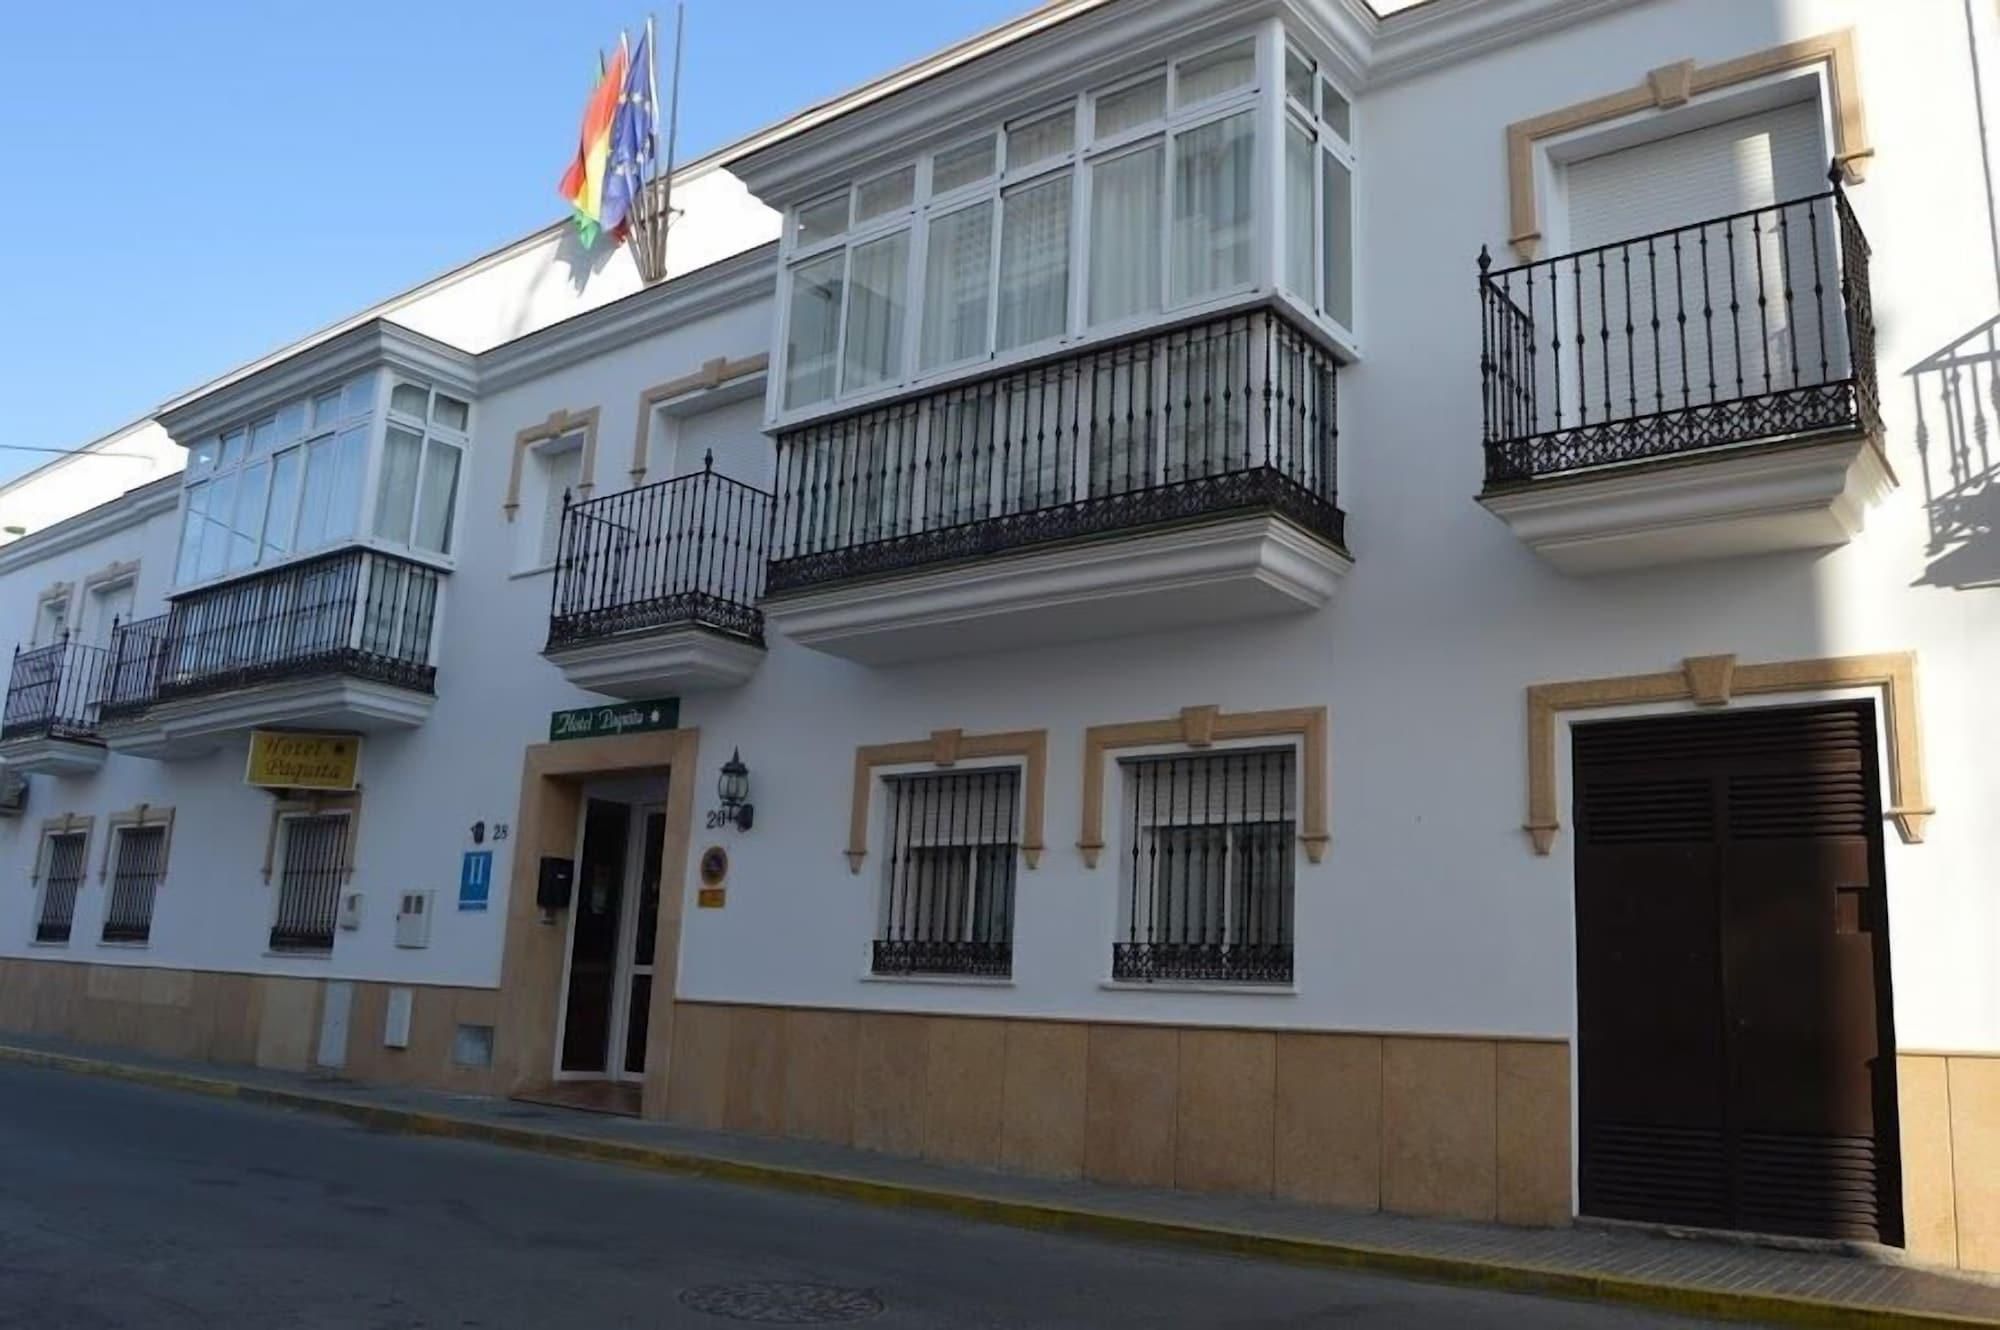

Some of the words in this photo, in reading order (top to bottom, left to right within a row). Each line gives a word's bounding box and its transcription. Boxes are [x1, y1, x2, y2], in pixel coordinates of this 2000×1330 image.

[555, 711, 593, 735] Hotel
[264, 736, 321, 757] Hotel
[264, 759, 340, 783] Paquita
